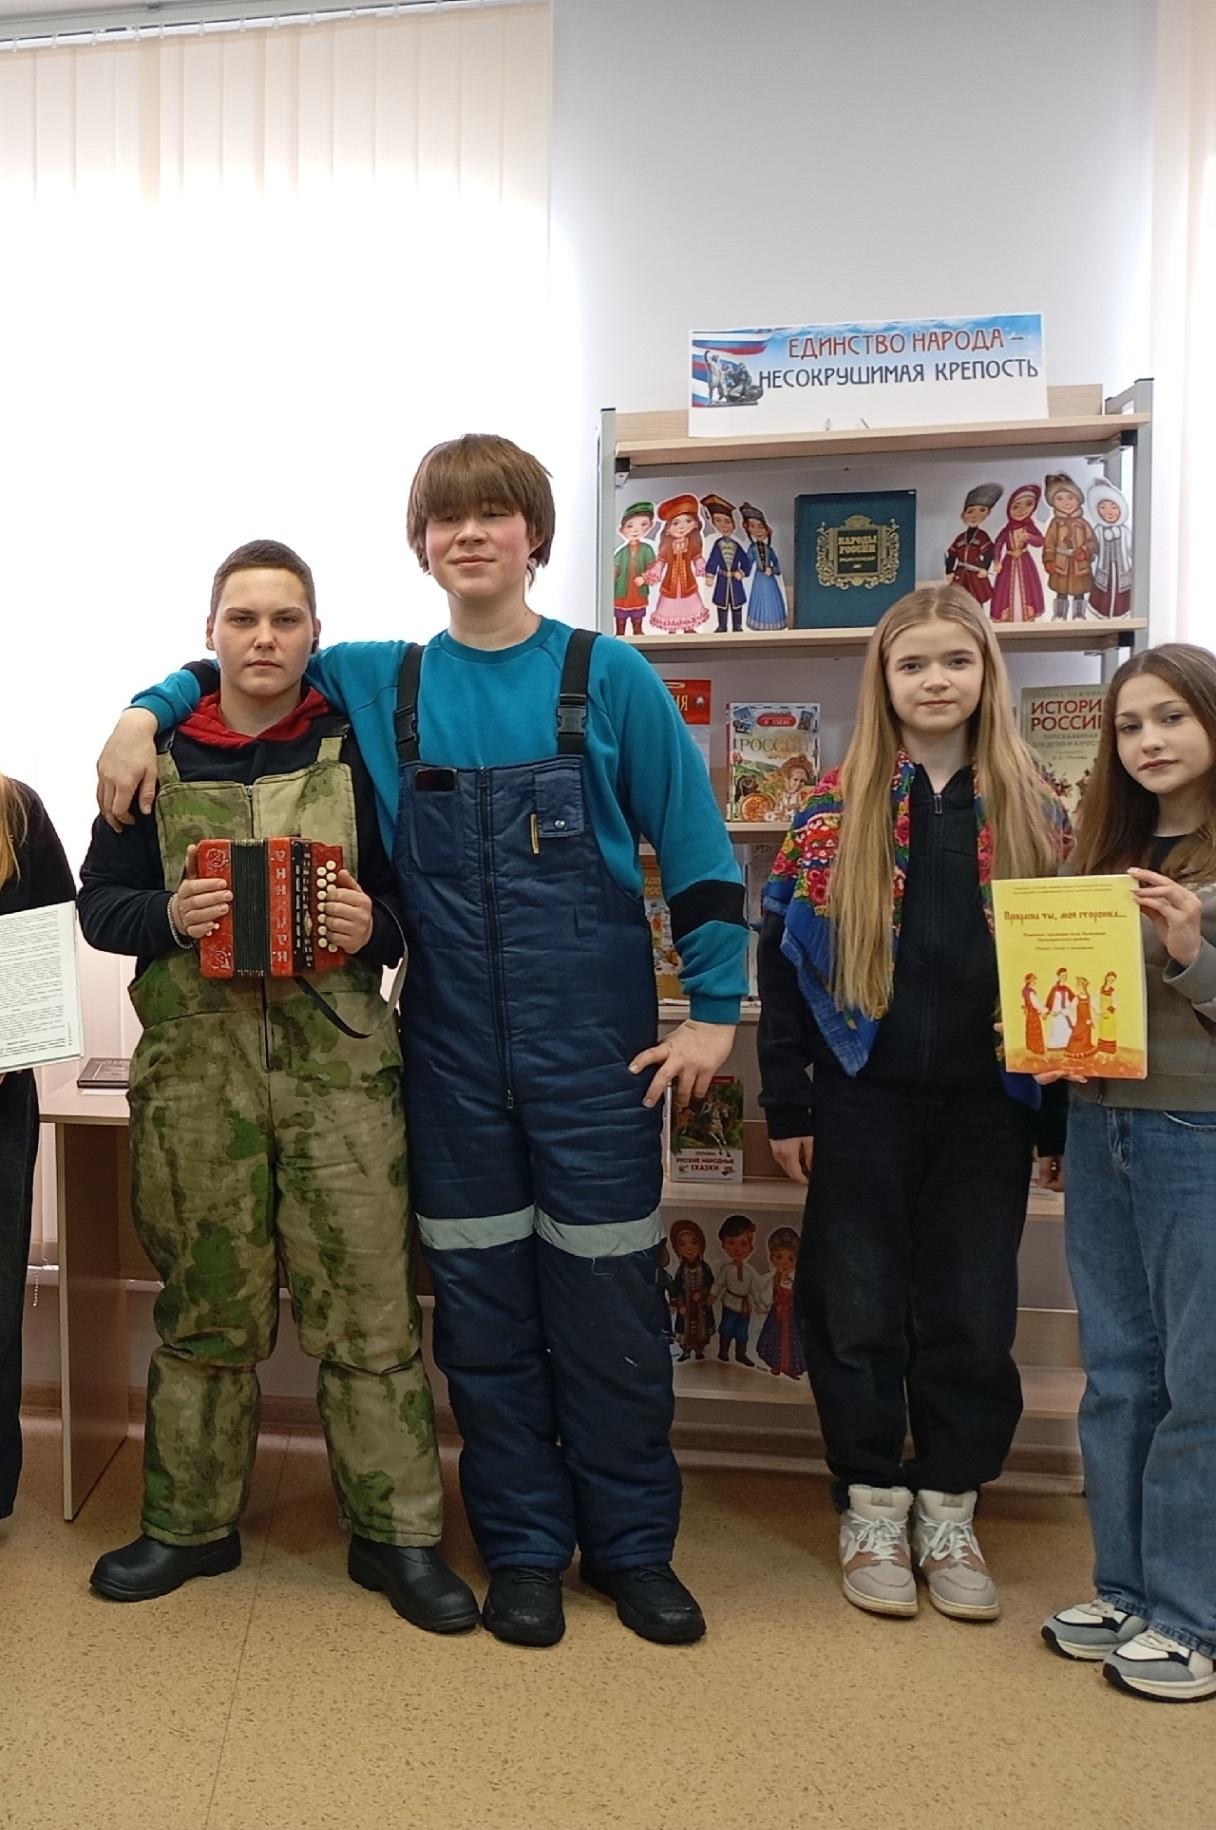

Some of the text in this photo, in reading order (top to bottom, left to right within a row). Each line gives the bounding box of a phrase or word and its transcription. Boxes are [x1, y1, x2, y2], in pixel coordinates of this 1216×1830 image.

[788, 334, 907, 360] ЕДИНСТВО
[912, 328, 1005, 353] НАРОДА
[759, 358, 1039, 389] НЕСОКРУШИМАЯ КРЕПОСТЬ
[1030, 698, 1103, 715] ИСТОРИ
